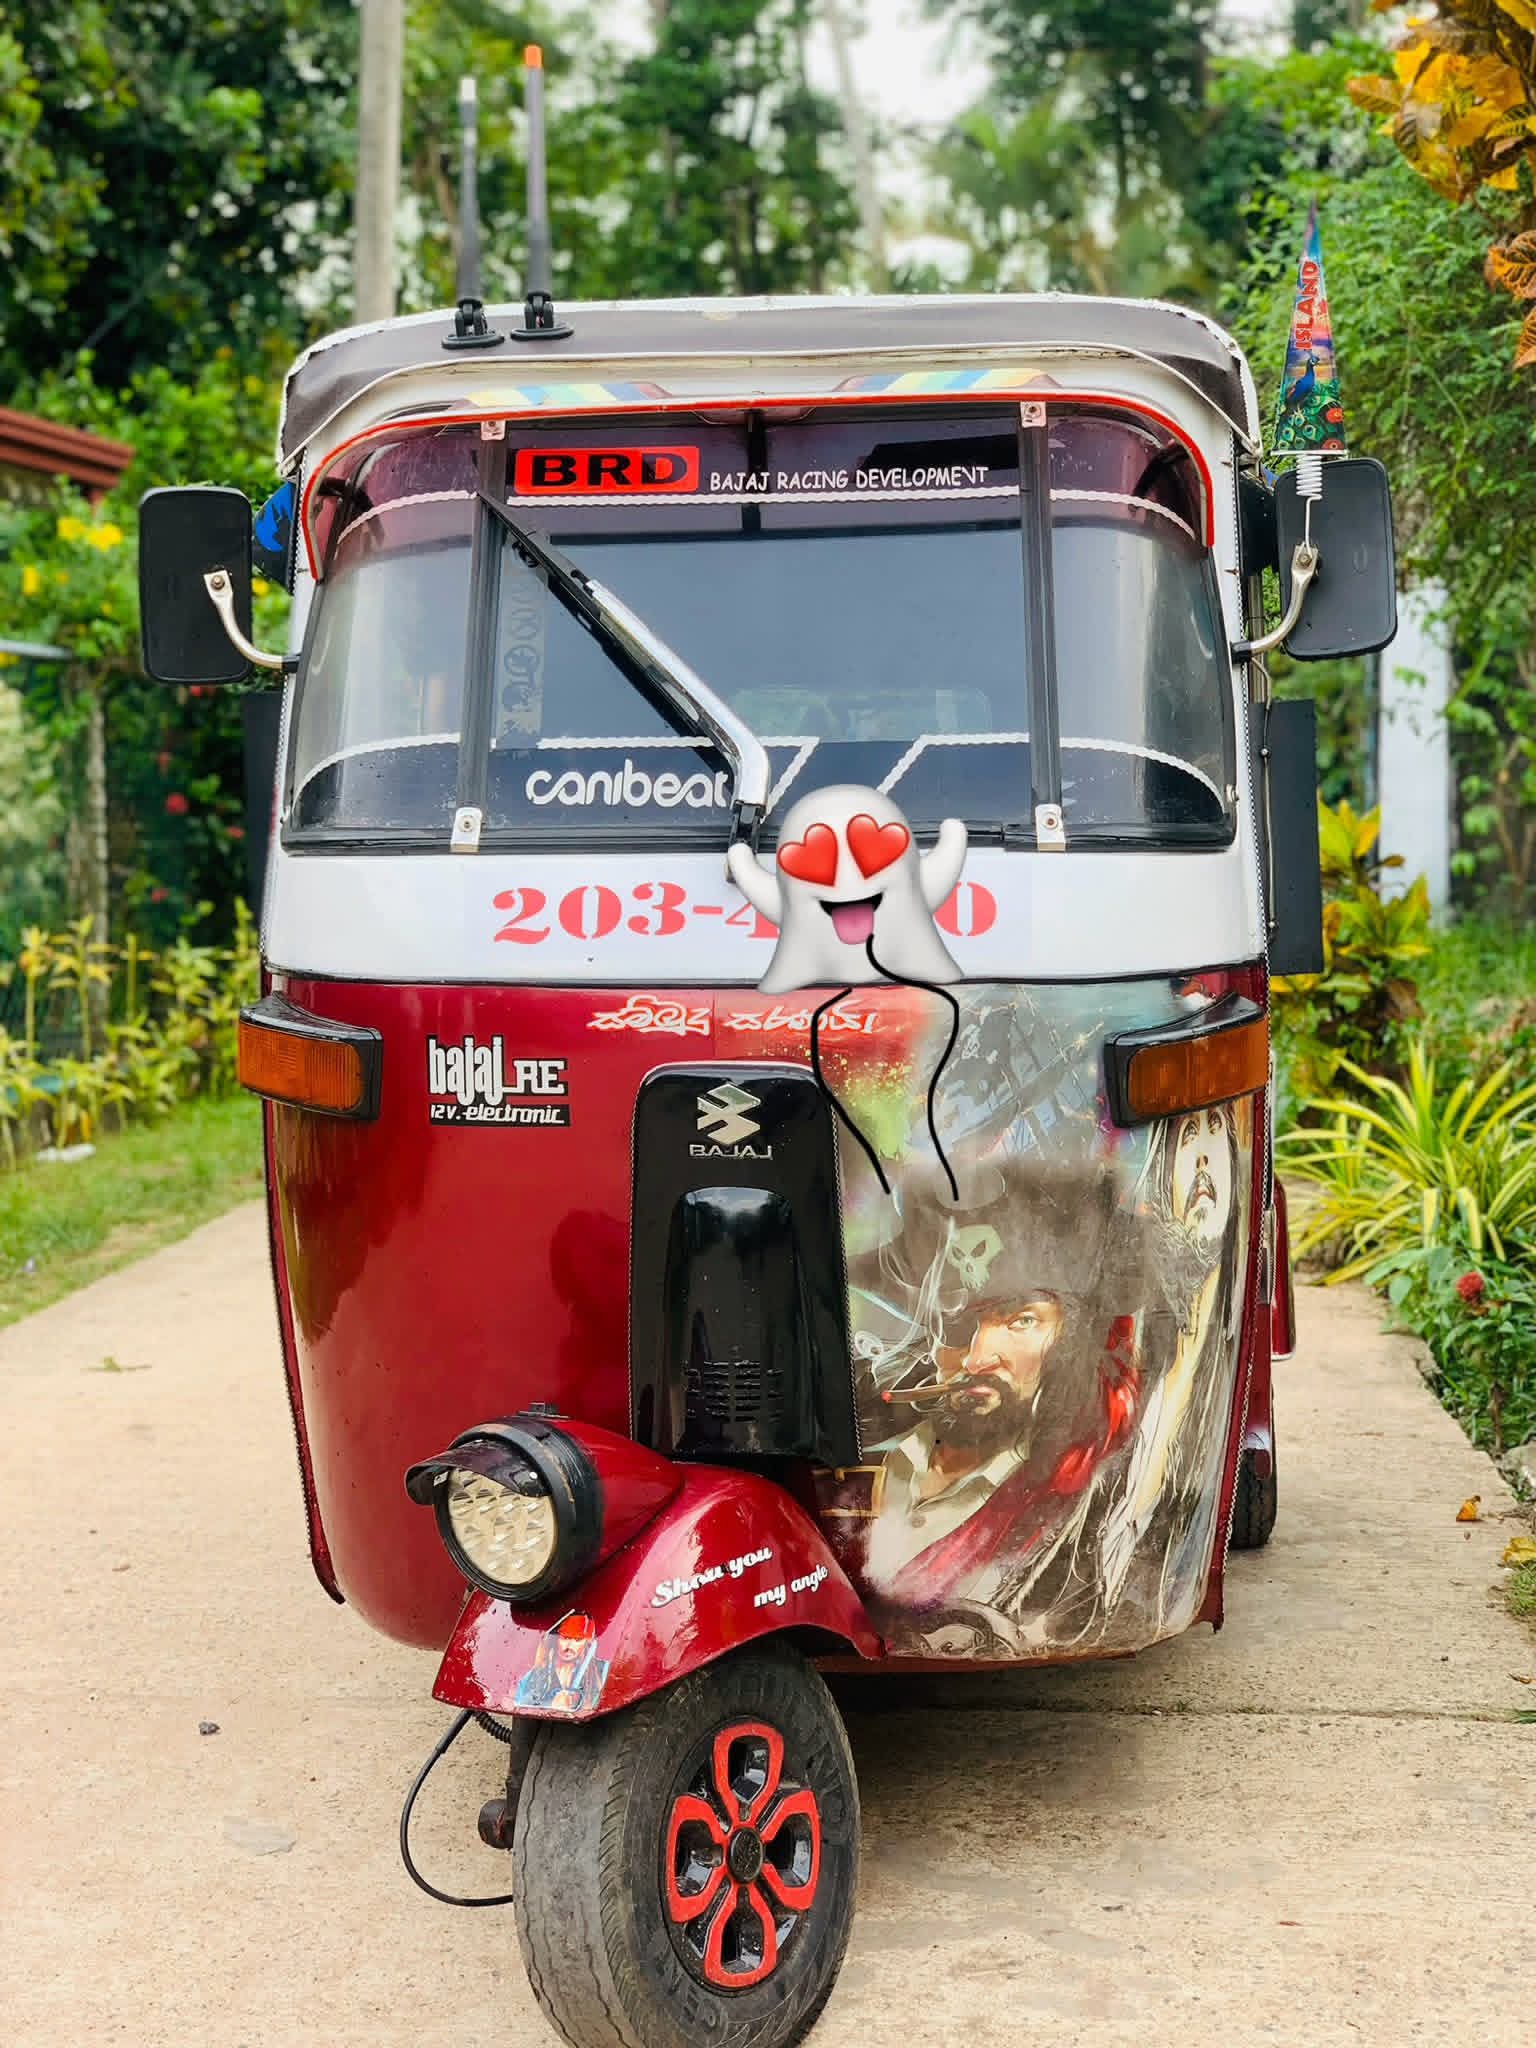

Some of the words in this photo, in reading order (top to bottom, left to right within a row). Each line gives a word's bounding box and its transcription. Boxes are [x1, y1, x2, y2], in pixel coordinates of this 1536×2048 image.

[1294, 260, 1320, 351] ISLAND
[530, 452, 689, 488] BRD
[709, 470, 771, 493] BAJAJ
[776, 469, 850, 490] RACING
[855, 465, 990, 489] DEVELOPMENT
[525, 758, 729, 808] canibeat
[428, 1036, 503, 1106] bajaj
[511, 1059, 566, 1095] RE
[688, 1143, 773, 1161] BAJAJ
[728, 1546, 773, 1579] you
[753, 1583, 787, 1608] my
[790, 1563, 829, 1594] angle
